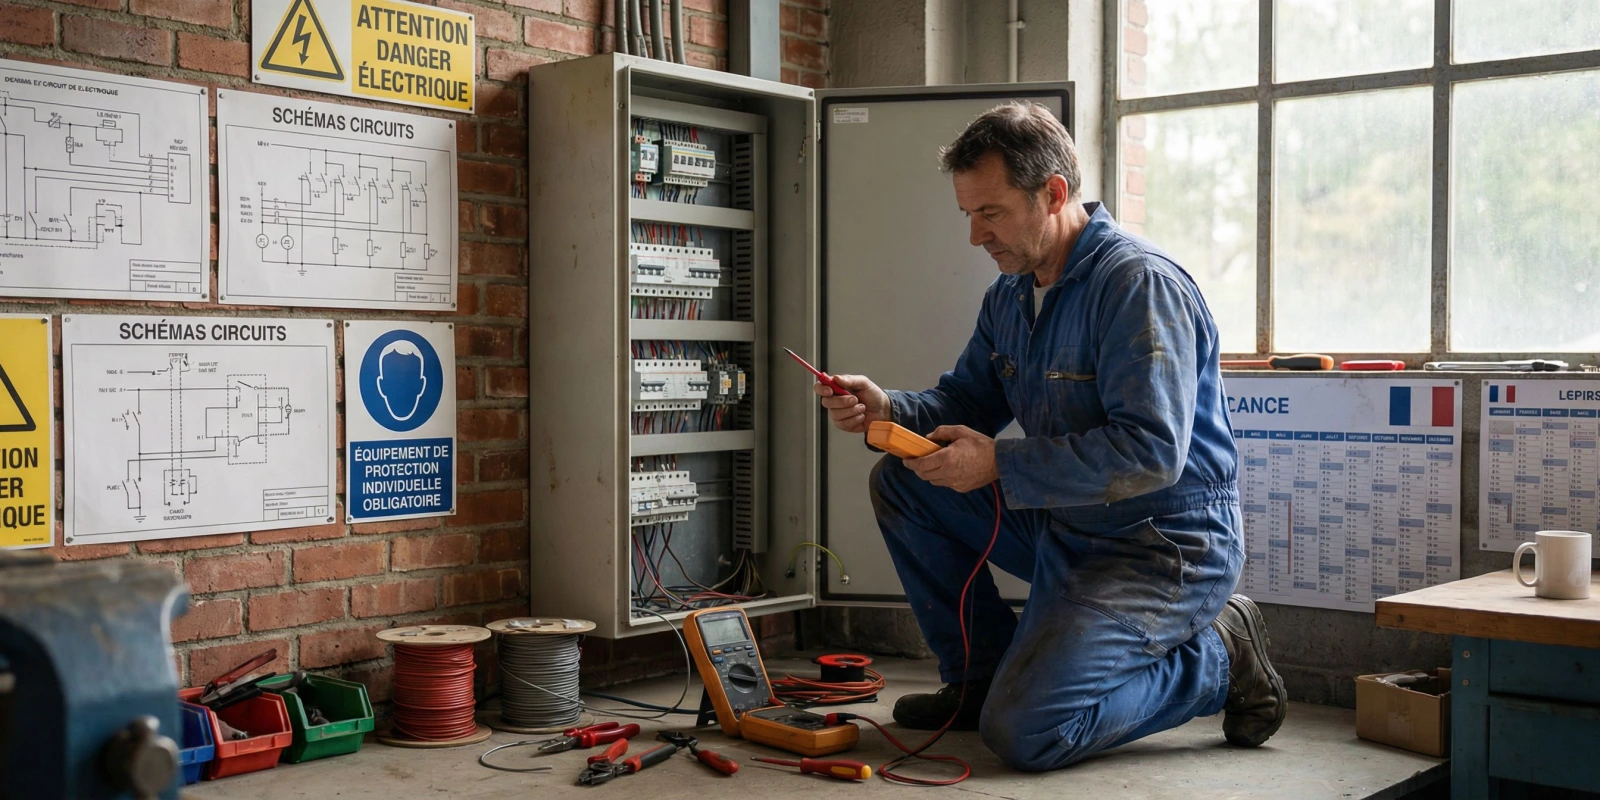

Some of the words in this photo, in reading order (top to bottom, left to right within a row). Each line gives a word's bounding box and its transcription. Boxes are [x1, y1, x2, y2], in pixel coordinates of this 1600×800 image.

[357, 4, 468, 46] ATTENTION
[377, 39, 452, 71] DANGER
[358, 61, 468, 102] ÉLECTRIQUE
[272, 106, 346, 130] SCHÉMAS
[351, 117, 414, 139] CIRCUITS
[119, 319, 206, 340] SCHÉMAS
[211, 324, 287, 341] CIRCUITS
[0, 447, 38, 469] ION
[355, 446, 431, 462] ÉQUIPEMENT
[433, 445, 449, 458] DE
[365, 462, 439, 478] PROTECTION
[362, 478, 441, 494] INDIVIDUELLE
[363, 494, 441, 511] OBLIGATOIRE
[0, 504, 45, 530] QUE
